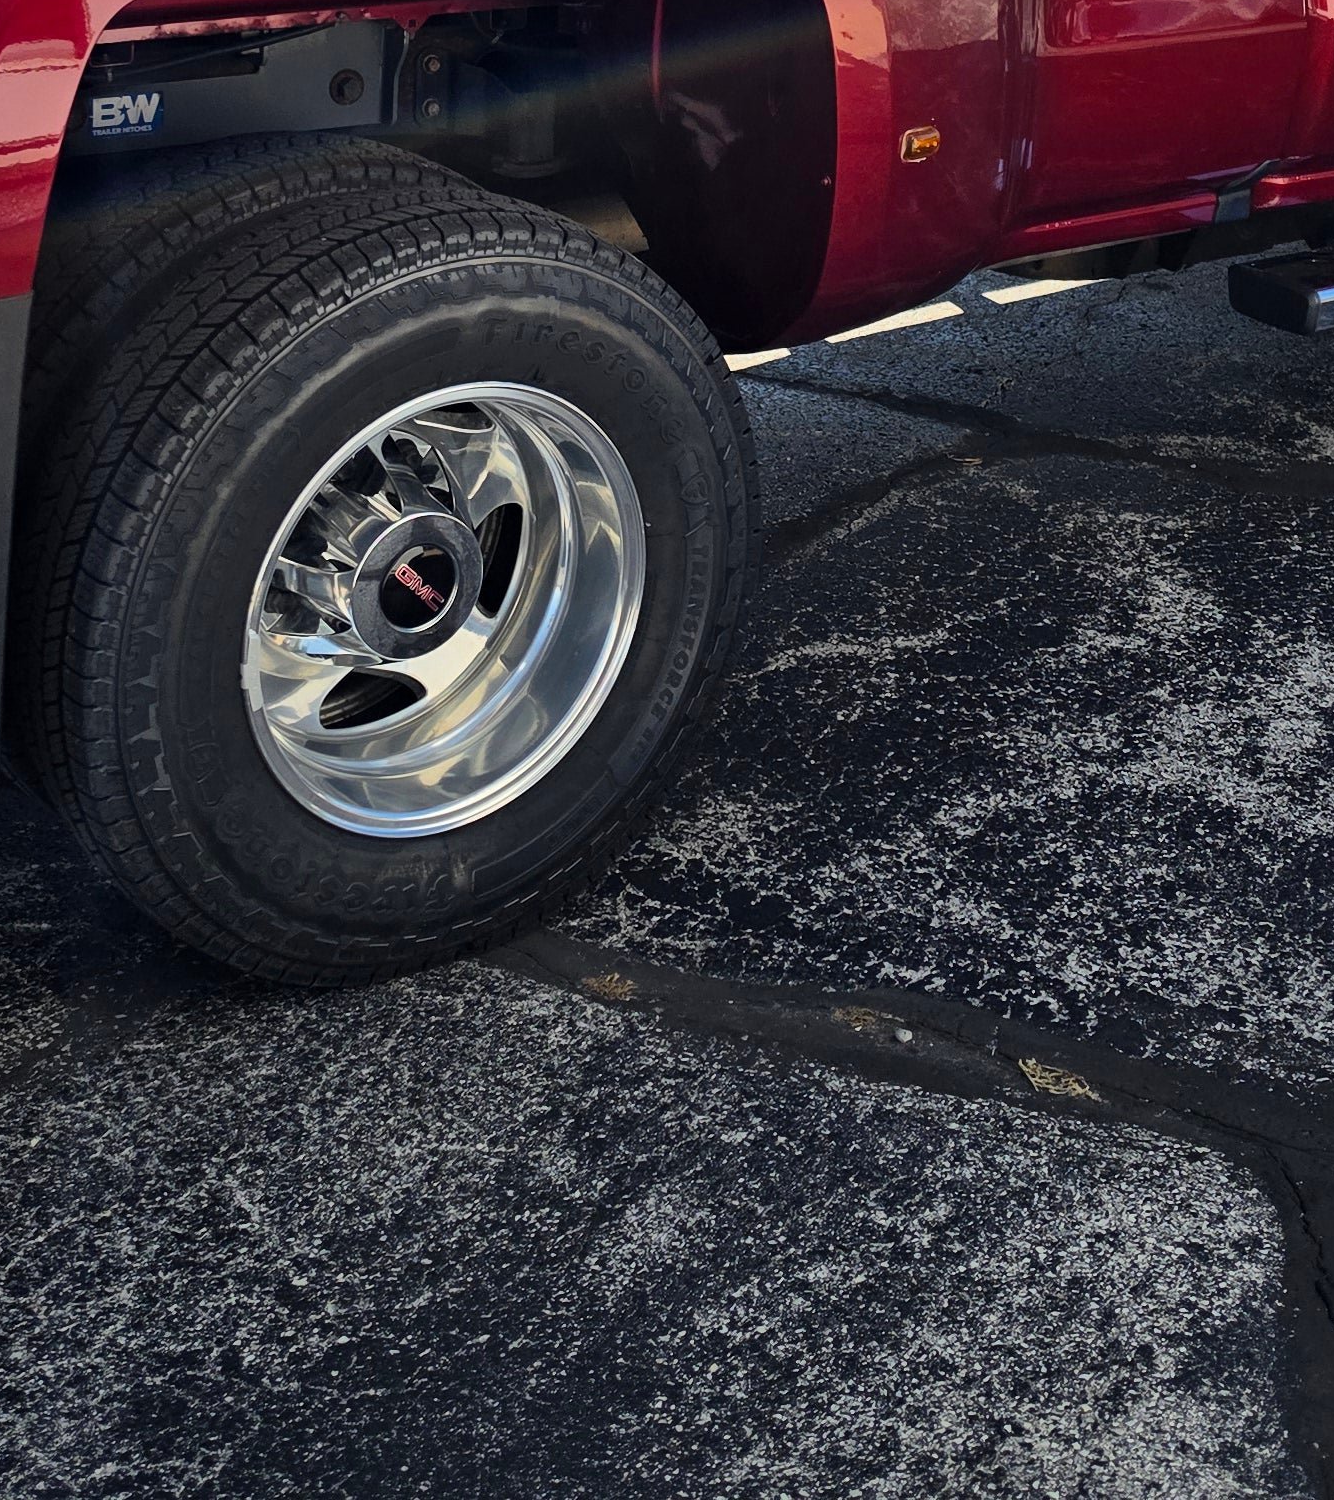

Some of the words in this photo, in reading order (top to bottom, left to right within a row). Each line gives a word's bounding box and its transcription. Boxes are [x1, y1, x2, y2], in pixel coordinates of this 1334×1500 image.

[92, 127, 122, 137] TRAILER
[483, 312, 685, 446] Firestone
[394, 563, 445, 612] GMC
[650, 545, 711, 722] TRANSFORCE
